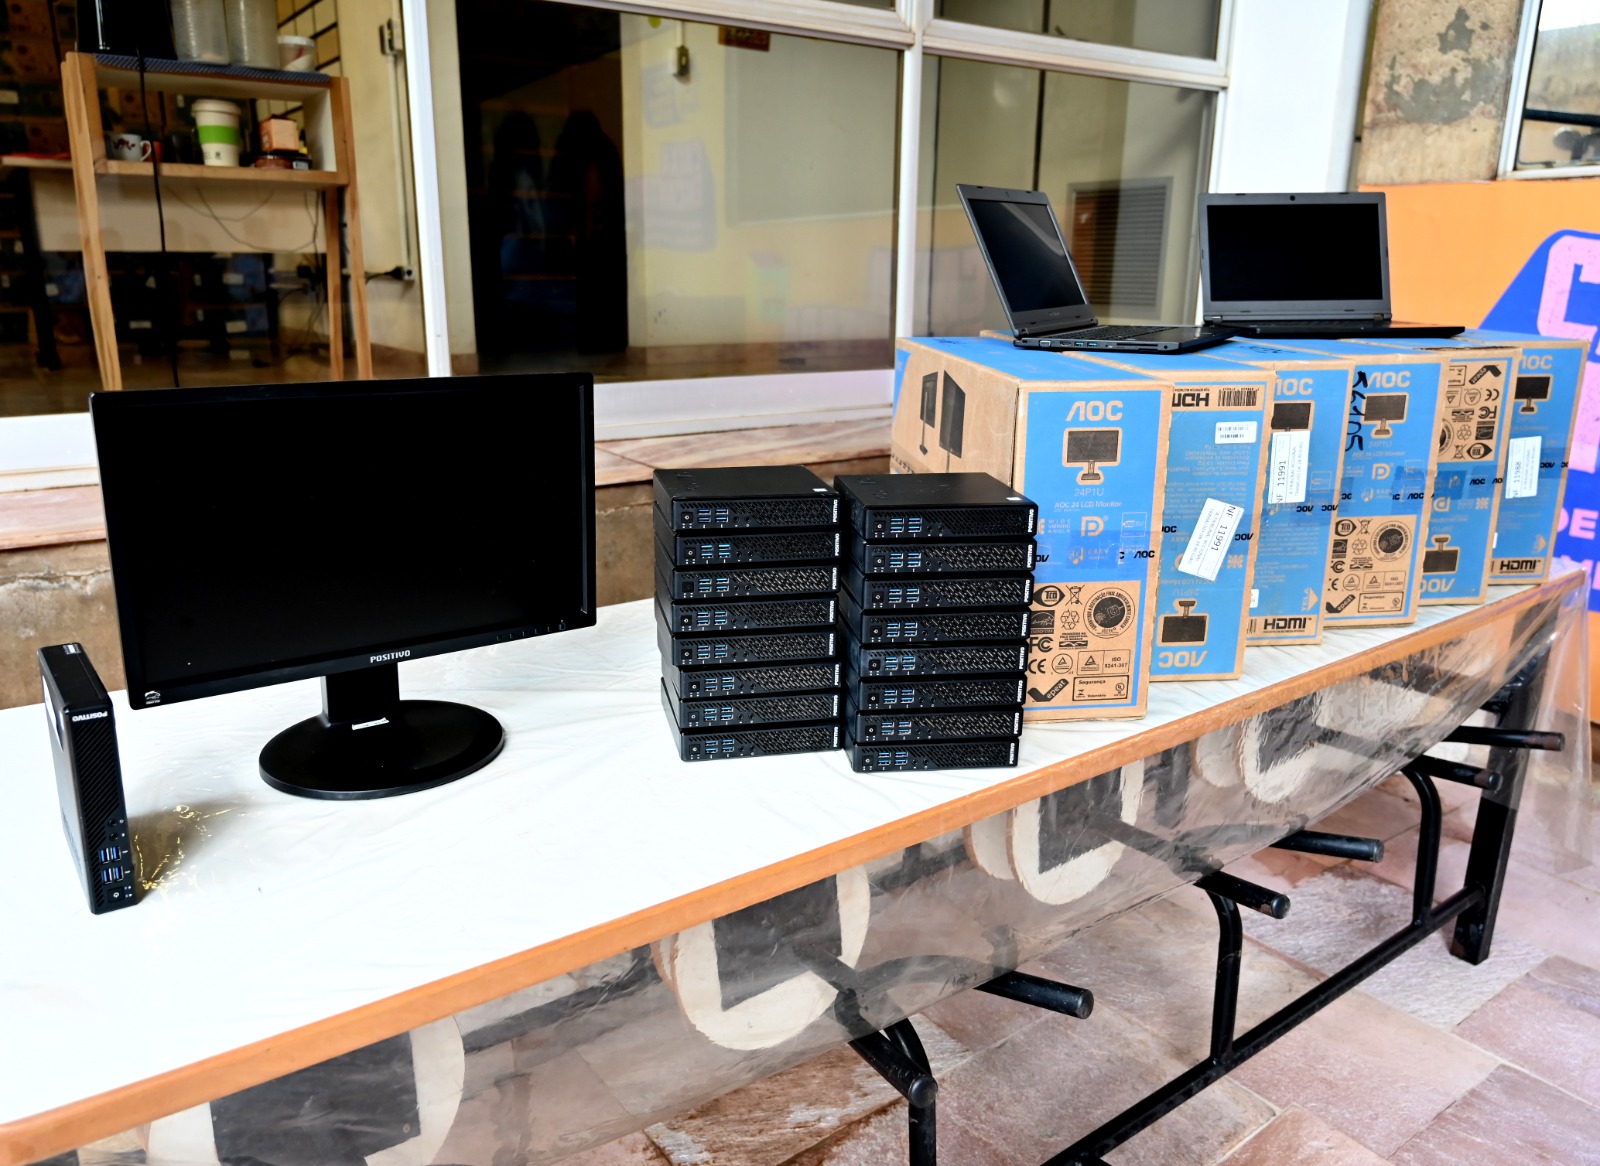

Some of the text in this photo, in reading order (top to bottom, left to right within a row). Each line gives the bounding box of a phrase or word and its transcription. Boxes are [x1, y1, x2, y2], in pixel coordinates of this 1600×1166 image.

[1368, 370, 1412, 388] AOC
[1066, 400, 1124, 422] AOC
[1277, 461, 1286, 486] 11991
[1074, 488, 1104, 497] 24P1U
[1211, 506, 1236, 551] NF 11991
[1234, 533, 1254, 541] AOC
[1134, 550, 1155, 559] AOC
[370, 650, 410, 663] POSITIVO
[1158, 650, 1207, 668] AOC
[1046, 679, 1066, 699] epeat
[72, 711, 108, 722] POSITIVO
